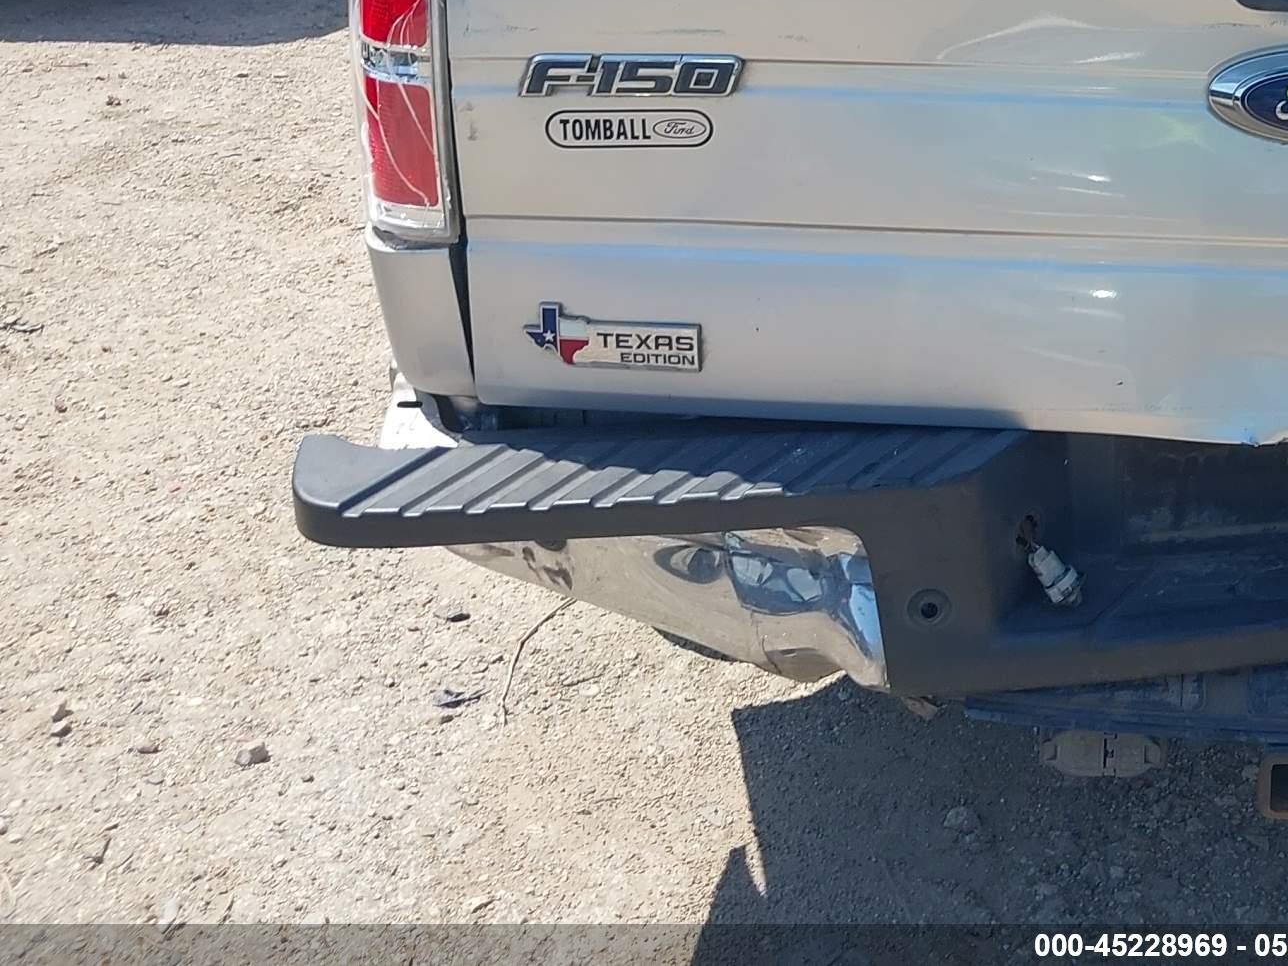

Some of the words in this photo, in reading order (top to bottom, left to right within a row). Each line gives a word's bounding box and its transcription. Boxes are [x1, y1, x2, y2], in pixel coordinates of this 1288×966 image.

[519, 53, 744, 97] F-150
[559, 117, 652, 142] TOMBALL
[663, 121, 696, 136] Ford
[596, 331, 695, 352] TEXAS
[619, 351, 696, 366] EDITION
